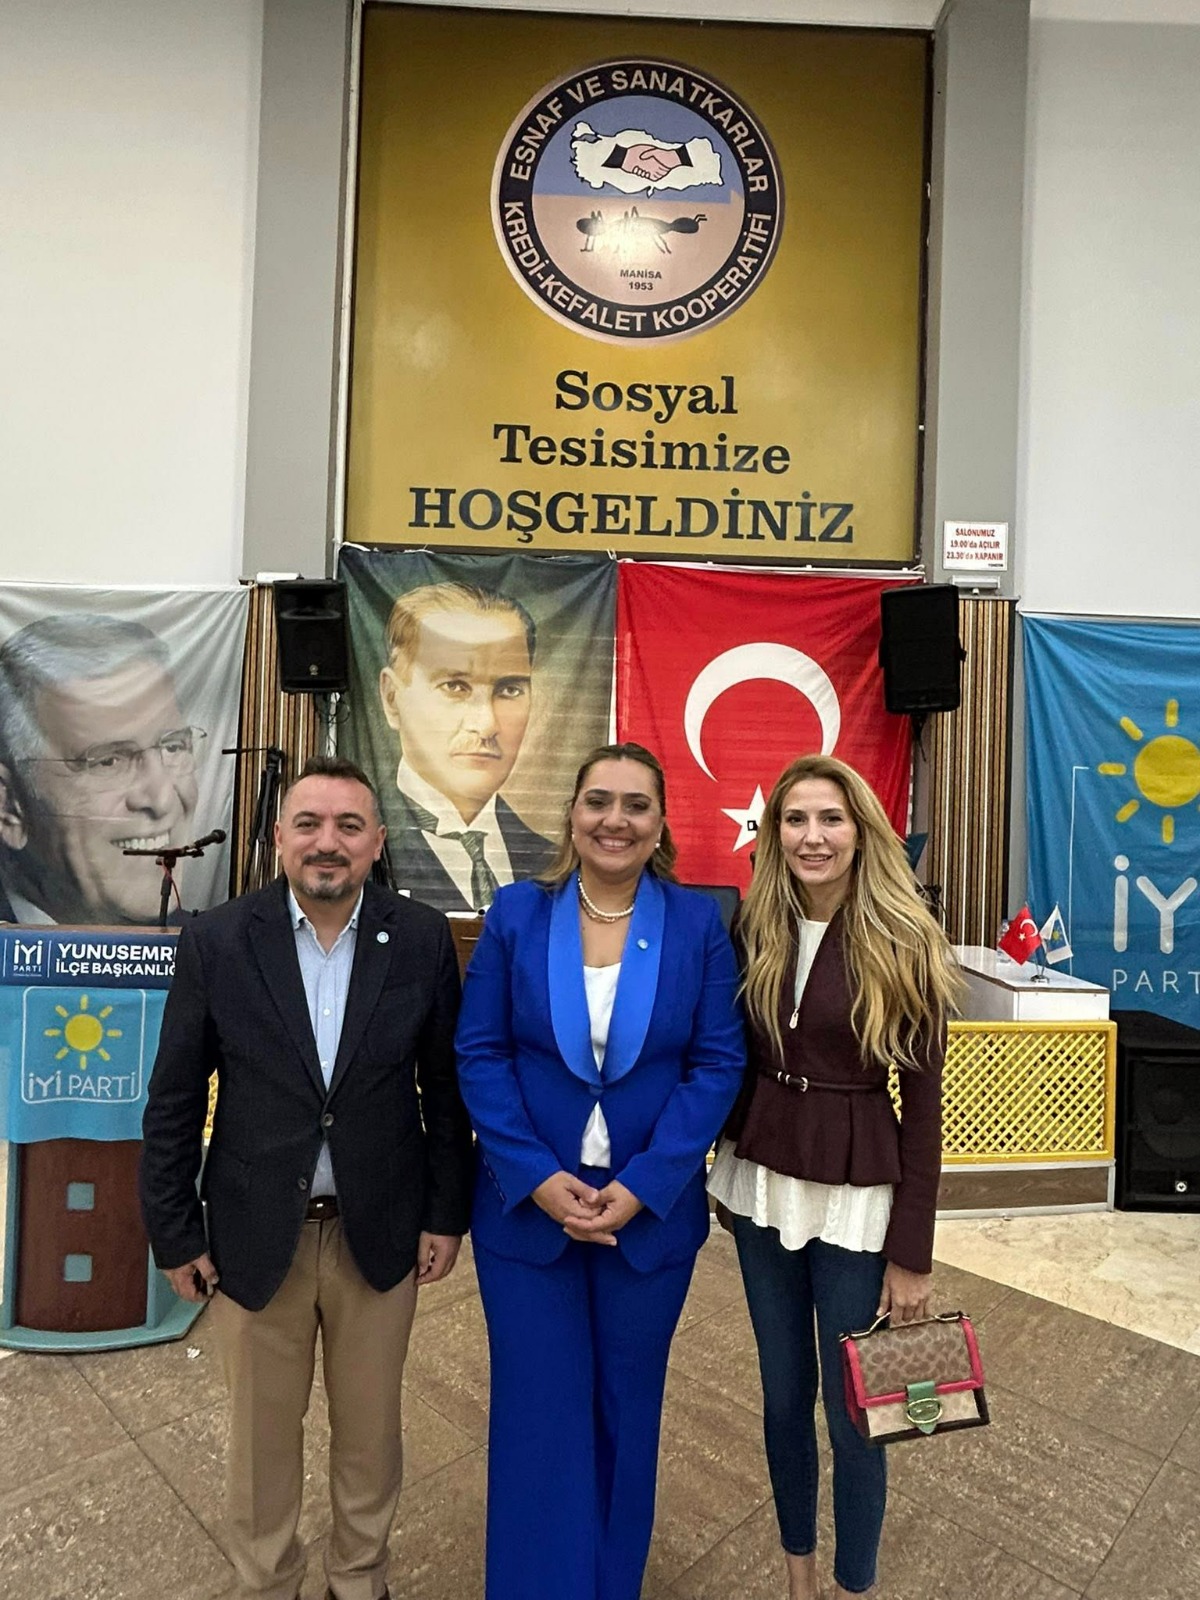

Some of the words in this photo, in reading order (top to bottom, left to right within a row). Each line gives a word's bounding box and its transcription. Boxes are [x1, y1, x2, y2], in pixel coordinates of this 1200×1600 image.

[510, 97, 566, 181] ESNAF
[567, 75, 605, 105] VE
[611, 69, 769, 193] SANATKARLAR
[504, 201, 647, 332] KREDİ-KEFALET
[653, 212, 772, 331] KOOPERATİFİ
[619, 268, 662, 280] MANİSA
[628, 281, 653, 291] 1953
[555, 369, 739, 424] Sosyal
[493, 423, 791, 475] Tesisimize
[408, 487, 855, 544] HOŞGELDİNİZ
[956, 528, 995, 537] SALONUMUZ
[58, 943, 177, 962] YUNUSEMR
[56, 958, 89, 976] İLÇE
[68, 1071, 136, 1098] PARTİ
